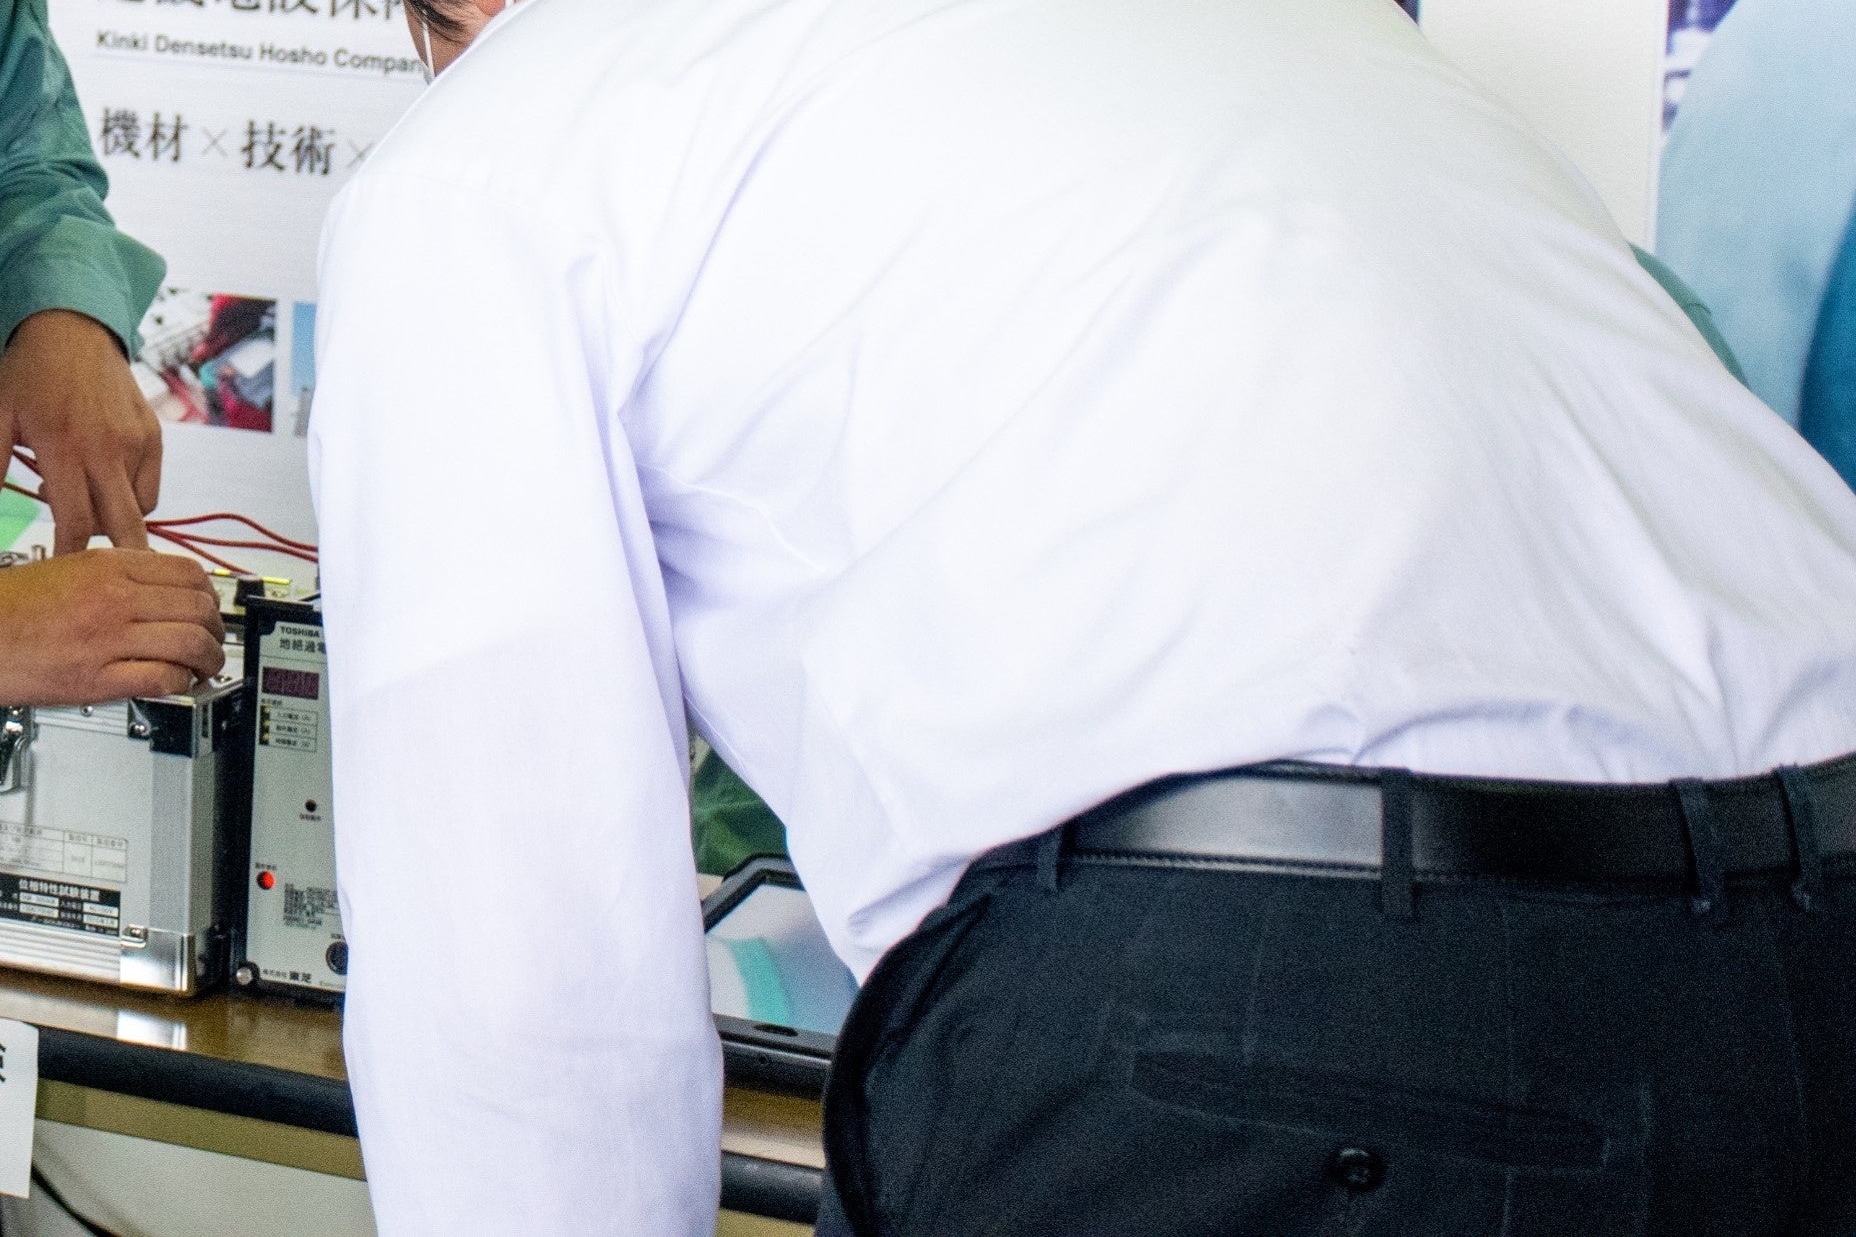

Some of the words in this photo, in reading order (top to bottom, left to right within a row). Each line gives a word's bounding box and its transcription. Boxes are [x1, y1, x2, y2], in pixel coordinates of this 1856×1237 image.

[96, 30, 147, 50] Kinki
[155, 34, 252, 60] Densetsu
[259, 42, 326, 66] Hosho
[334, 48, 425, 74] Compan
[280, 626, 320, 638] TOSHIBA
